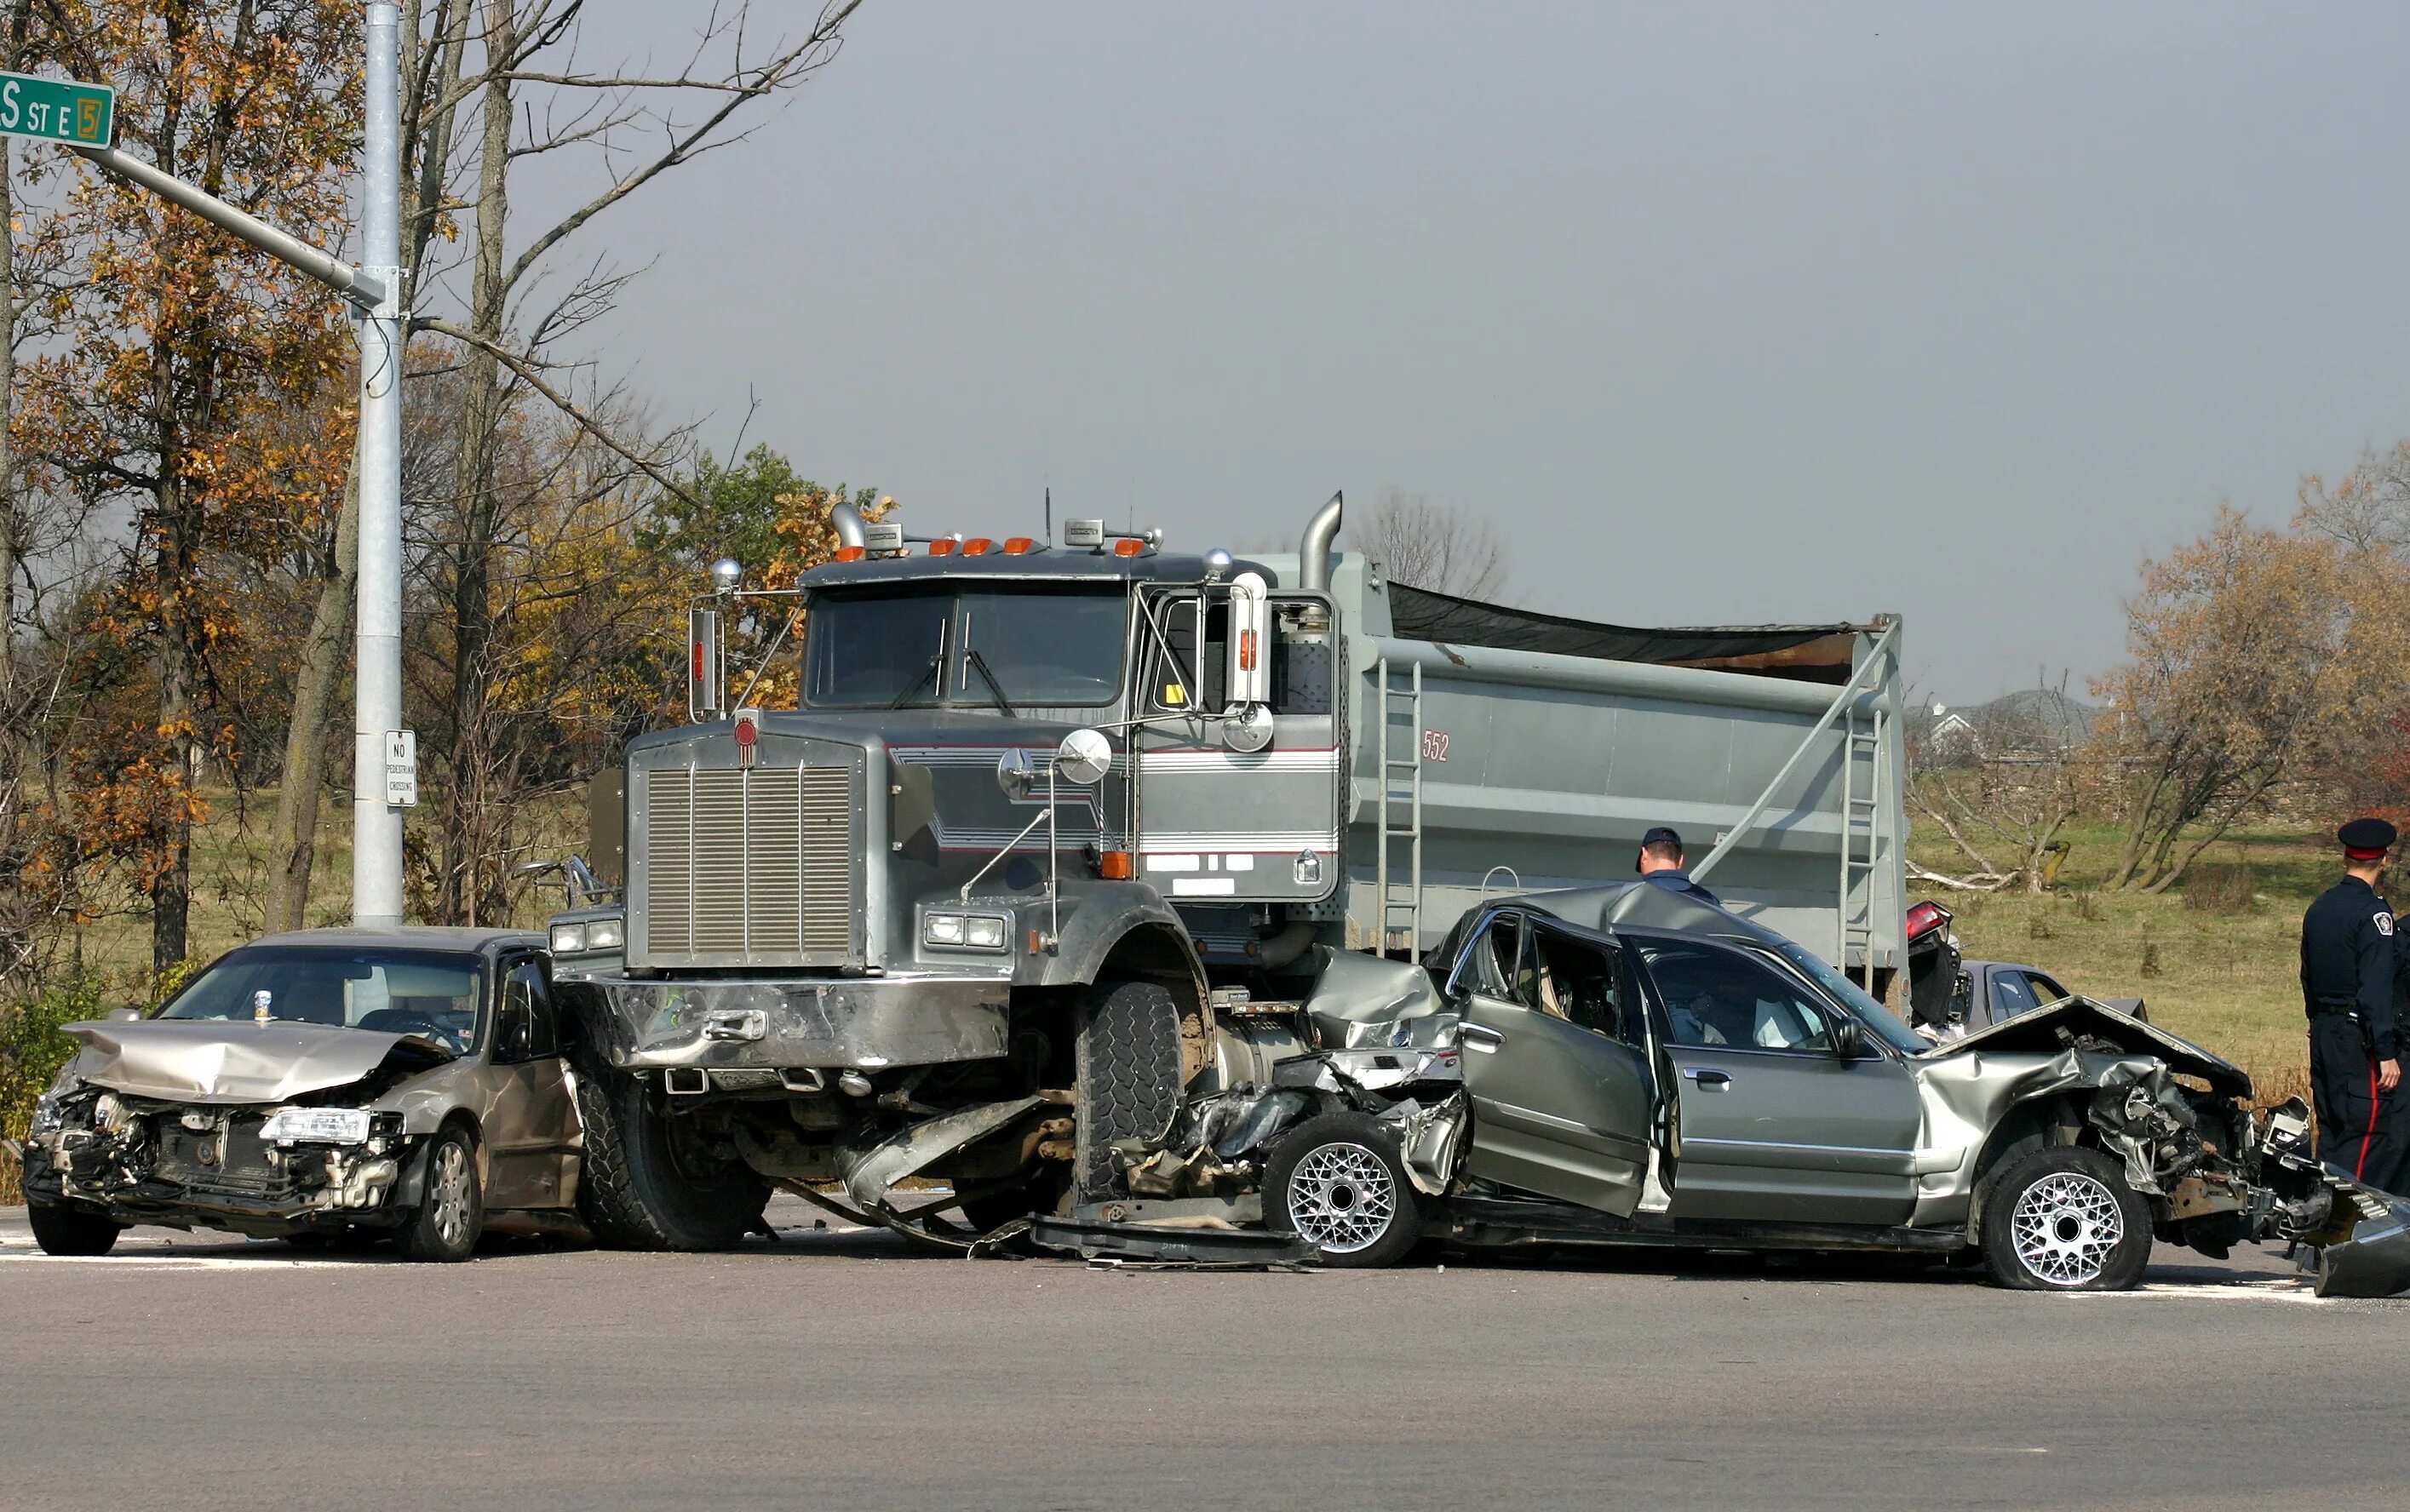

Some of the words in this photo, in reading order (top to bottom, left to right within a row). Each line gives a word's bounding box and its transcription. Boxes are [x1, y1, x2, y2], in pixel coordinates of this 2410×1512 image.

[0, 80, 20, 129] S
[27, 101, 50, 132] ST
[58, 106, 72, 136] E
[82, 104, 96, 133] 5
[393, 743, 405, 758] NO
[1423, 729, 1449, 762] 552
